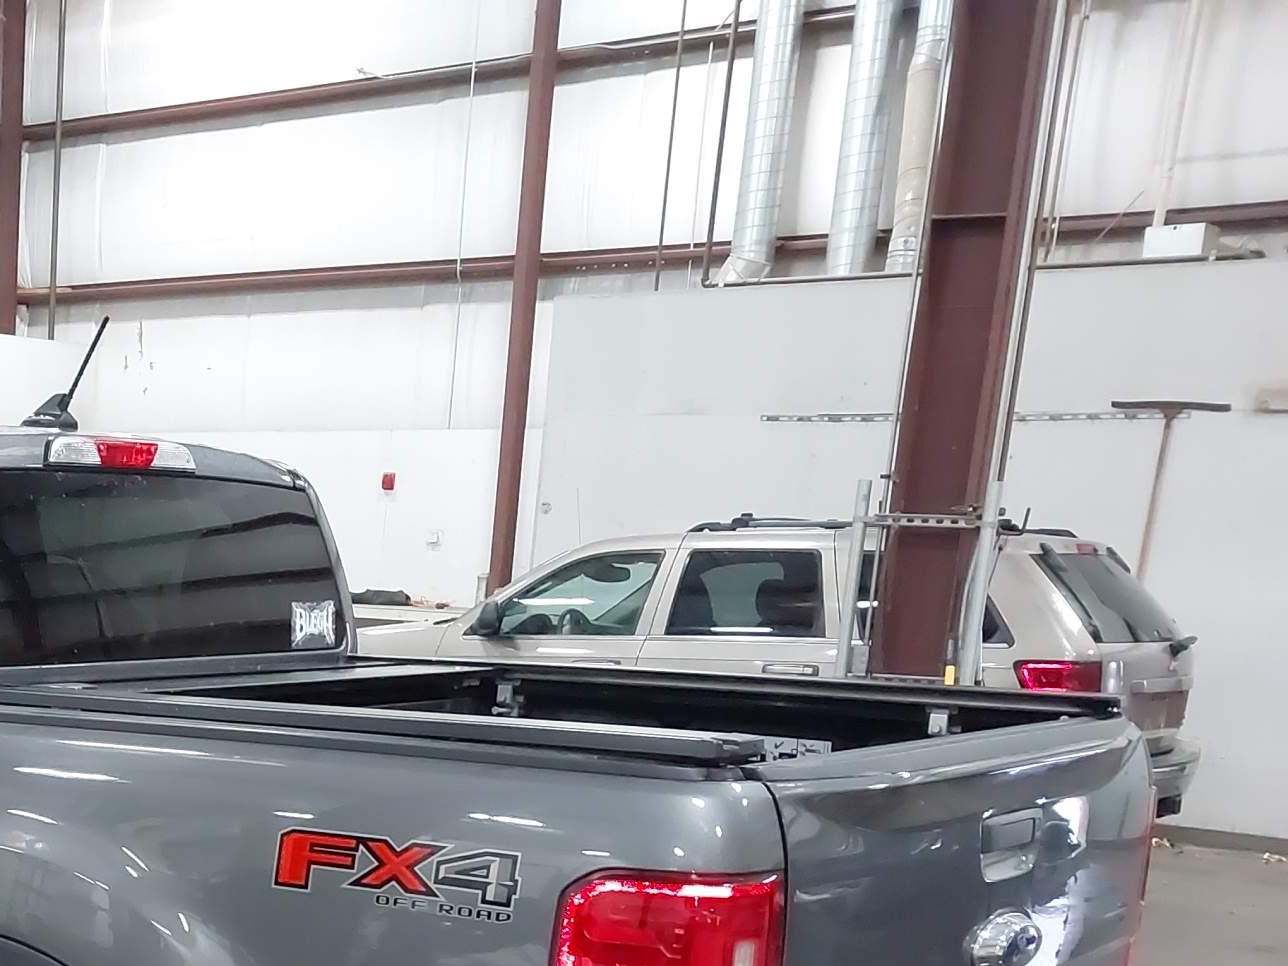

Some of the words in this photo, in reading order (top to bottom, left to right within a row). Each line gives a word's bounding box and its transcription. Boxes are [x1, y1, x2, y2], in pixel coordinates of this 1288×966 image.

[272, 827, 521, 909] FX4
[374, 894, 428, 911] OFF
[438, 903, 513, 923] ROAD
